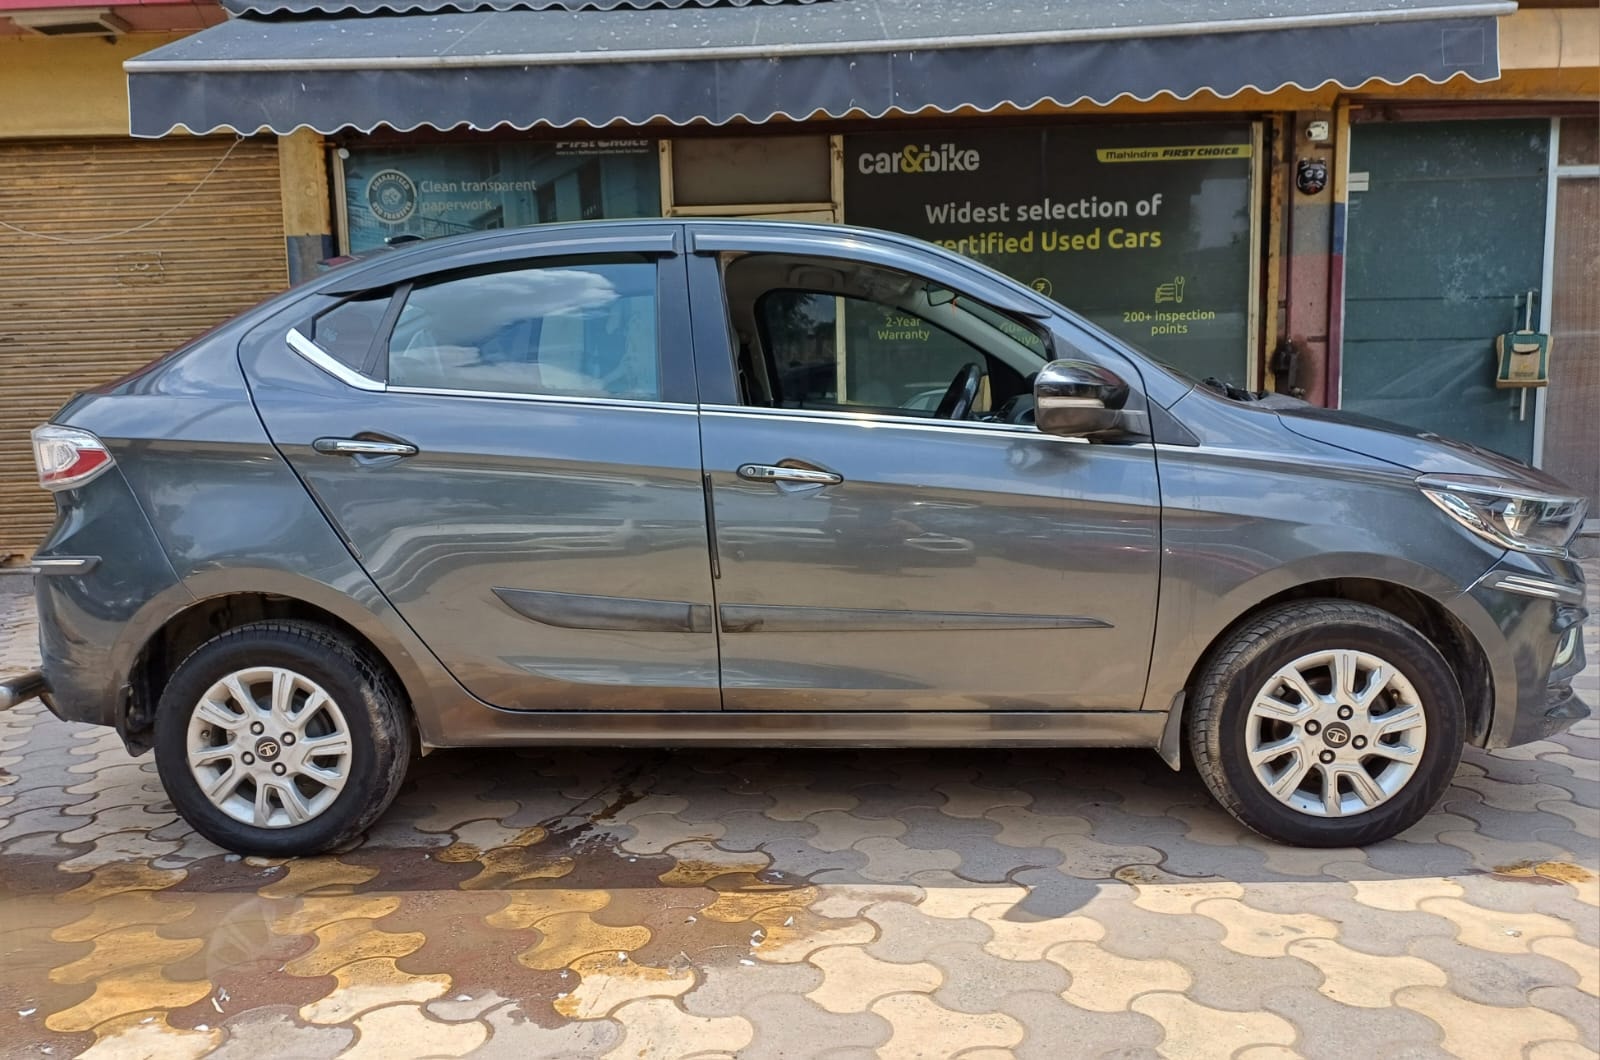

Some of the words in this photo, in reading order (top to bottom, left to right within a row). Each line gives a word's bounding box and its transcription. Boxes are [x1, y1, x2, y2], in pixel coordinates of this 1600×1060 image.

[858, 143, 980, 174] car&bike
[1106, 151, 1159, 160] Mahindra
[1162, 149, 1195, 157] FIRST
[1197, 147, 1239, 156] CHOICE
[420, 180, 457, 193] Clean
[461, 179, 537, 194] transparent
[925, 201, 1010, 224] Widest
[1016, 197, 1128, 222] selection
[1135, 193, 1163, 217] of
[933, 230, 1034, 254] ertified
[1041, 228, 1101, 251] Used
[1107, 228, 1163, 249] Cars
[885, 317, 921, 328] 2-Year
[1122, 312, 1152, 323] 200+
[1155, 309, 1216, 323] inspection
[876, 330, 930, 342] Warranty
[1151, 323, 1189, 337] points
